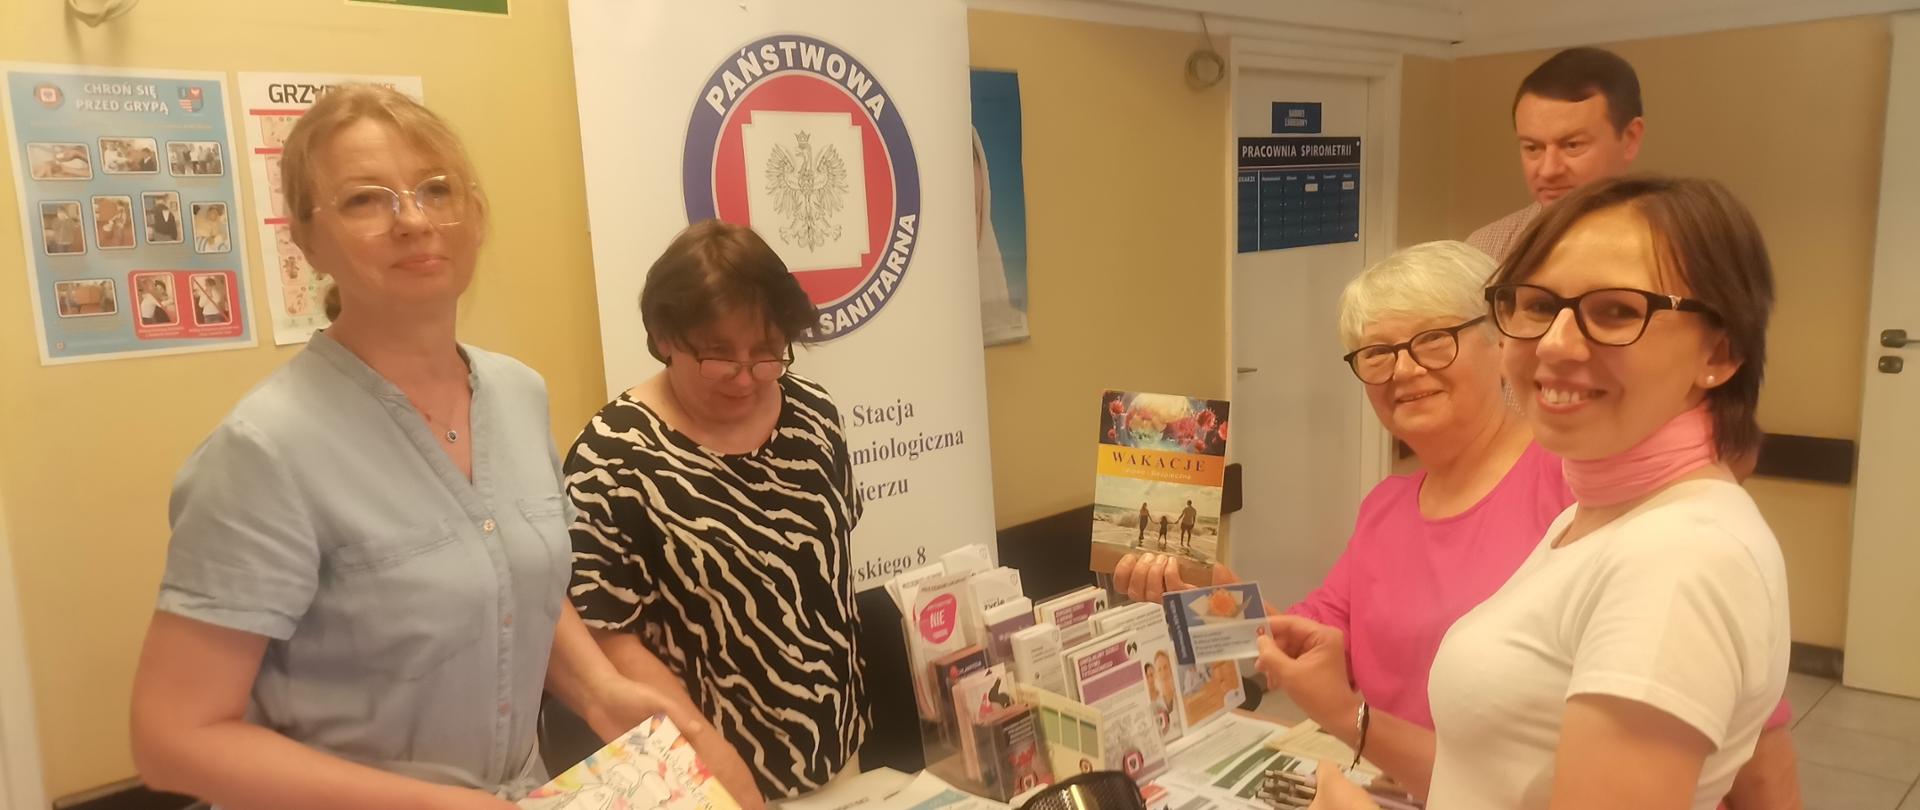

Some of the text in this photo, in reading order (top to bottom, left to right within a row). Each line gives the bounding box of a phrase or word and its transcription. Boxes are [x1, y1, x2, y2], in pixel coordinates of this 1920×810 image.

[83, 82, 157, 99] CHROŃ SIĘ
[705, 41, 886, 121] PAŃSTWOWA
[268, 83, 337, 104] GRZY
[76, 98, 169, 116] PRZED GRYPĄ
[1242, 144, 1352, 158] PRACOWNIA SPIROMETRII
[819, 214, 916, 336] SANITARNA
[852, 398, 914, 428] Stacja
[851, 430, 964, 466] miologiczna
[1112, 451, 1205, 472] WAKACJE
[917, 546, 927, 566] 8
[930, 609, 945, 629] NIE
